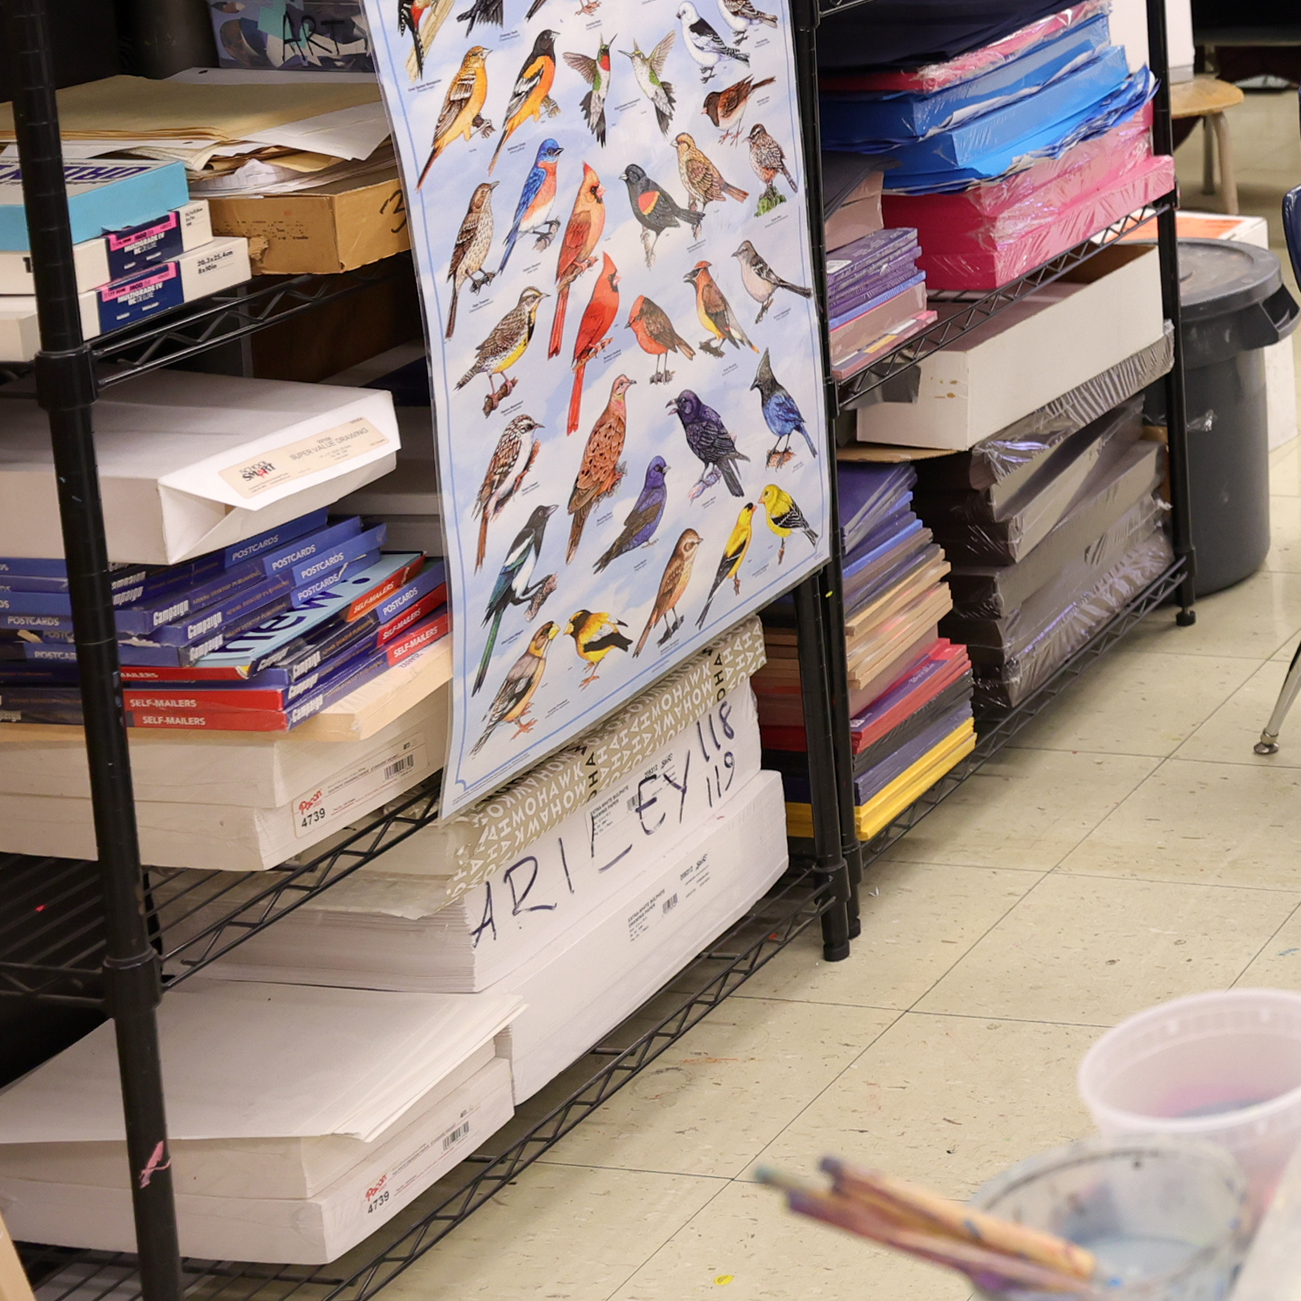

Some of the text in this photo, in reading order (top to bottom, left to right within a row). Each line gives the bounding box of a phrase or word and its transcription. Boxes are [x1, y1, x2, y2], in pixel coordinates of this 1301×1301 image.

[124, 234, 157, 253] MULTIGRADE
[117, 285, 155, 302] MULTIGRADE
[312, 440, 336, 454] VALUE
[336, 427, 369, 445] DRAWING
[239, 460, 268, 473] SCHOOL
[242, 463, 276, 482] SMART
[232, 534, 279, 561] POSTCARDS
[272, 545, 316, 571] POSTCARDS
[301, 552, 344, 579] POSTCARDS
[297, 574, 339, 601] POSTCARDS
[354, 581, 395, 614] SELF-MAILERS
[153, 599, 189, 626] Campaign
[383, 587, 418, 616] POSTCARDS
[8, 617, 60, 627] POSTCARDS
[188, 611, 222, 640] Campaign
[382, 608, 421, 640] SELF-MAILERS
[34, 651, 77, 660] POSTCAR
[393, 626, 438, 658] SELF-MAILERS
[293, 651, 321, 679] Campaign
[129, 699, 197, 709] SELF-MAILERS
[652, 660, 711, 722] MOHAWK
[142, 716, 206, 726] SELF-MAILERS
[513, 761, 585, 827] MOHAWK
[301, 807, 326, 828] 4739
[367, 1191, 389, 1214] 4739
